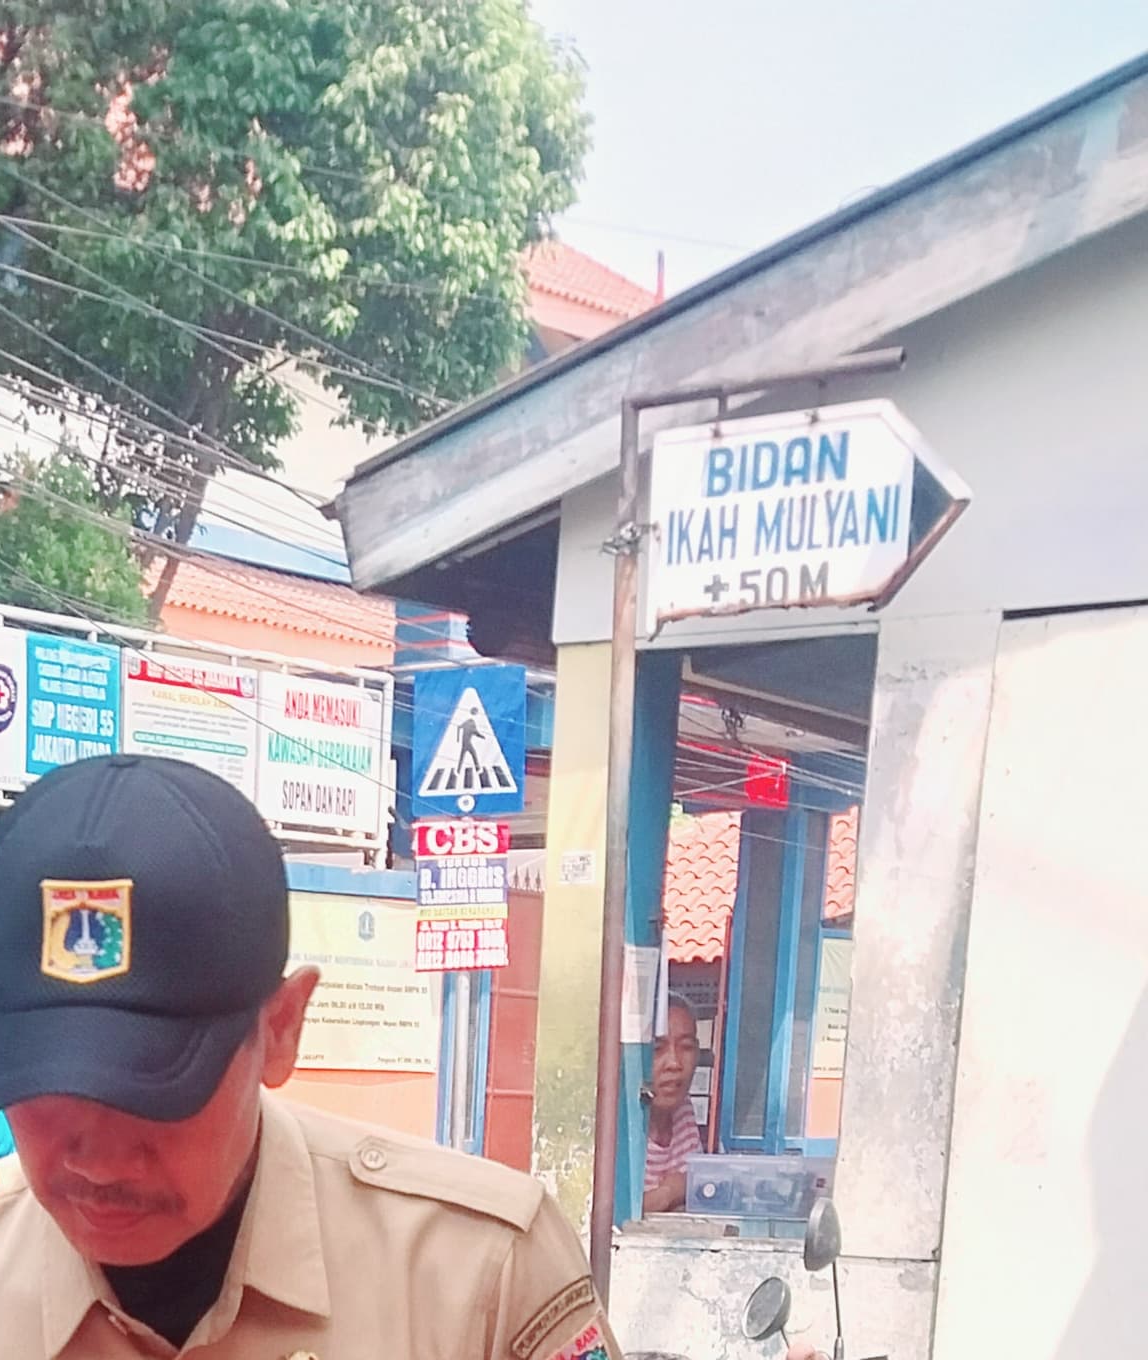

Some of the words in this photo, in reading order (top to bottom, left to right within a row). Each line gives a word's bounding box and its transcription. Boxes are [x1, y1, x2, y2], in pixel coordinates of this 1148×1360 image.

[705, 430, 850, 498] BIDAN
[667, 503, 740, 567] IKAH
[753, 484, 901, 557] MULYANI
[56, 702, 98, 735] NEGERI
[99, 708, 115, 737] 55
[284, 689, 310, 720] ANDA
[313, 693, 361, 728] MEMASUKI
[268, 732, 314, 767] KAWASAN
[282, 780, 313, 812] SOPAN
[315, 784, 333, 814] DAN
[335, 786, 356, 817] RAPI
[426, 824, 499, 855] CBS
[440, 866, 505, 889] INGGRIS
